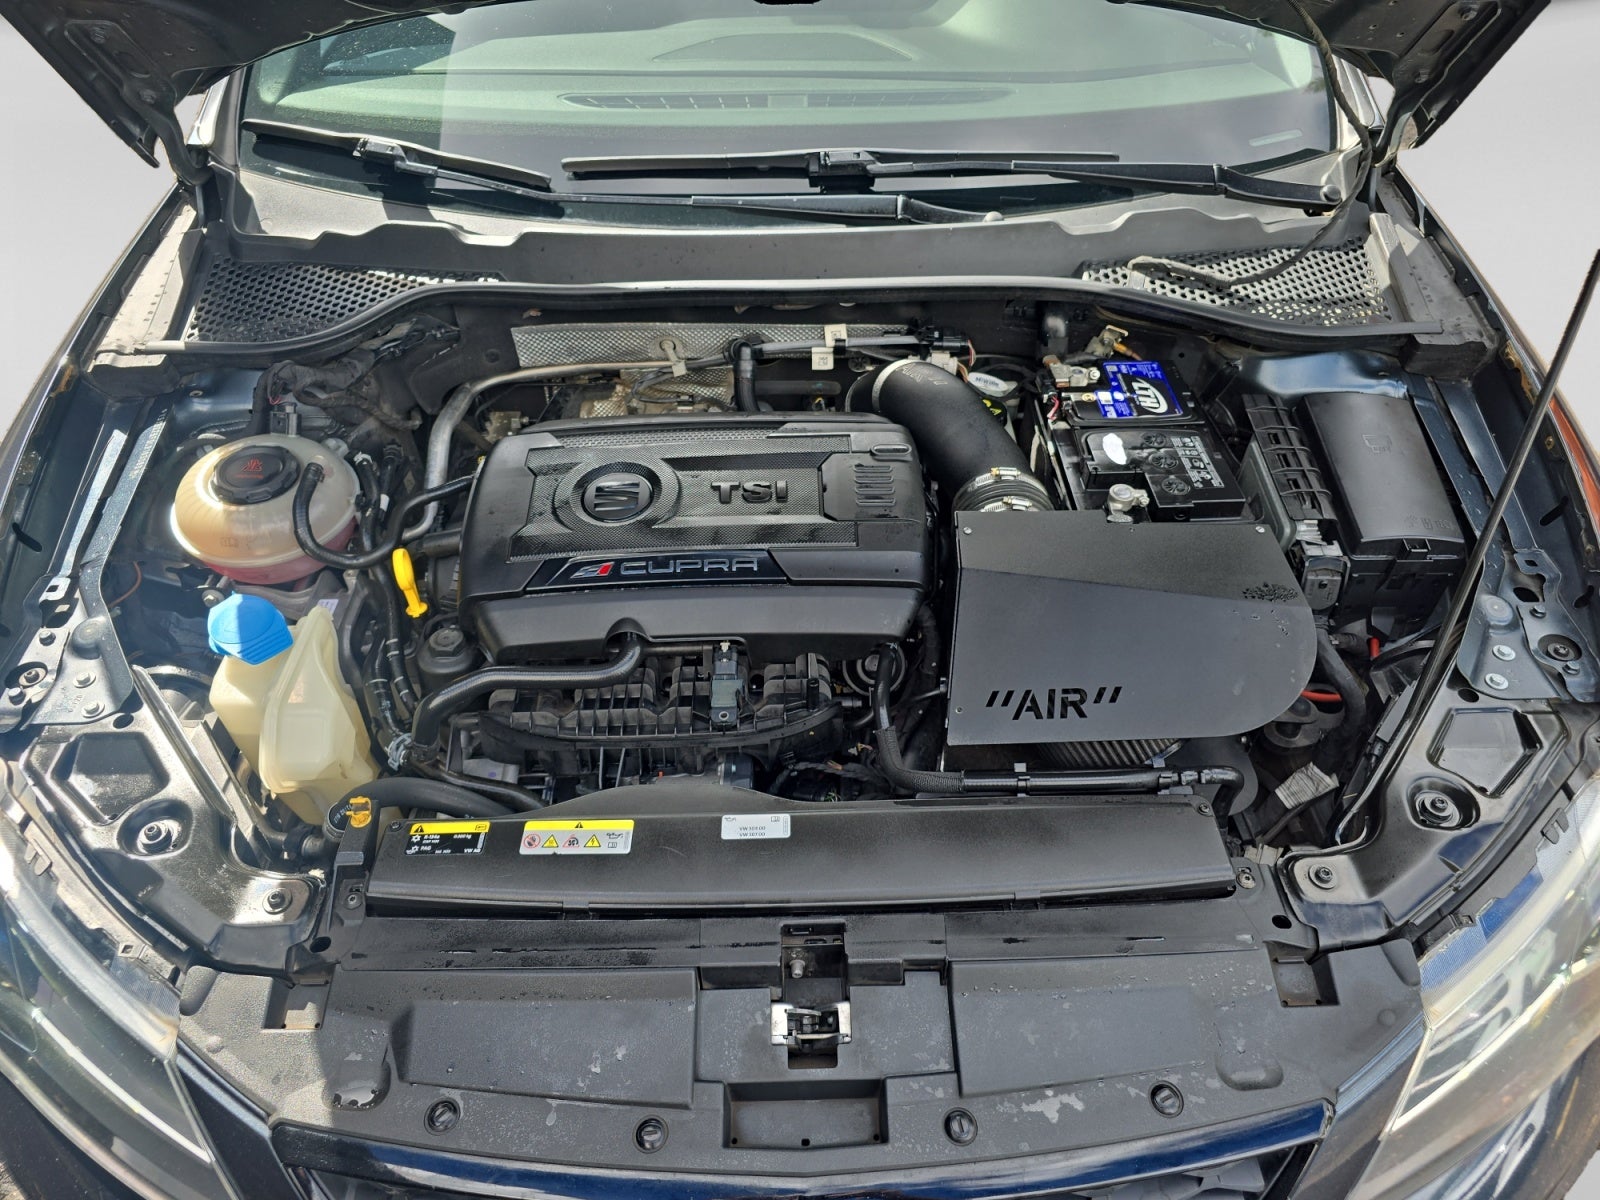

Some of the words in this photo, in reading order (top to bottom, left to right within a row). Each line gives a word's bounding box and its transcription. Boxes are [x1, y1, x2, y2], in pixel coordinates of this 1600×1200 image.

[1131, 381, 1161, 409] LTH
[711, 480, 788, 504] TSI
[620, 558, 758, 575] CUPRA
